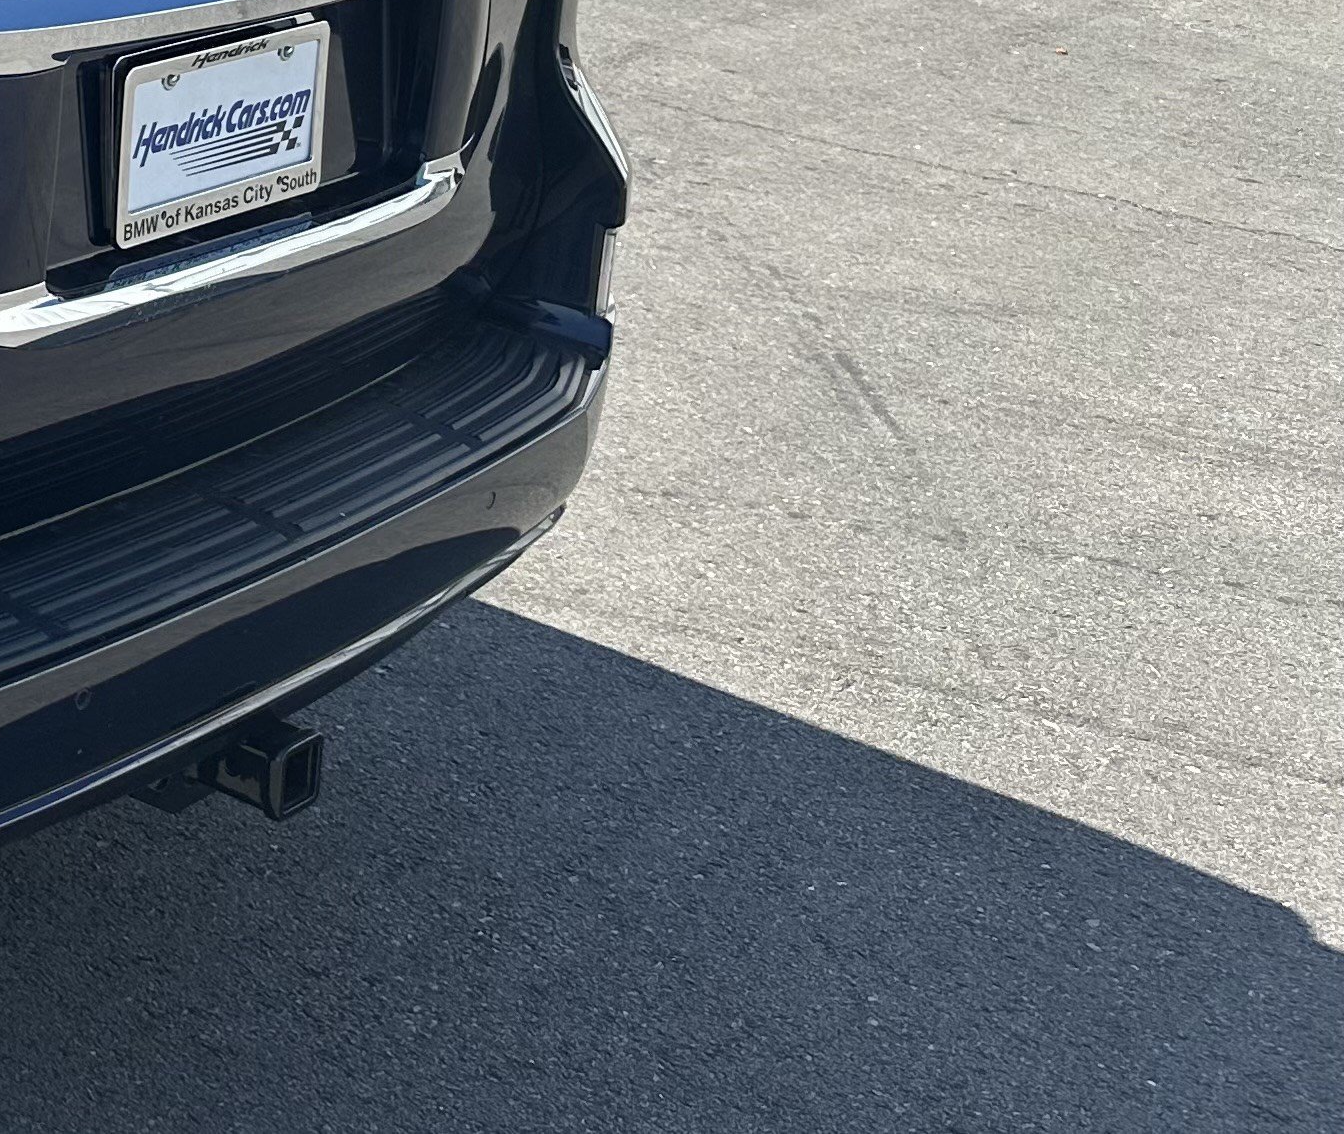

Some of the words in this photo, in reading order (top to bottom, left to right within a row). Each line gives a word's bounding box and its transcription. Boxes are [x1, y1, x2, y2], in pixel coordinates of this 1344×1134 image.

[191, 39, 271, 69] Hendrick
[165, 208, 182, 229] of
[184, 194, 239, 224] Kansas
[243, 183, 274, 204] City
